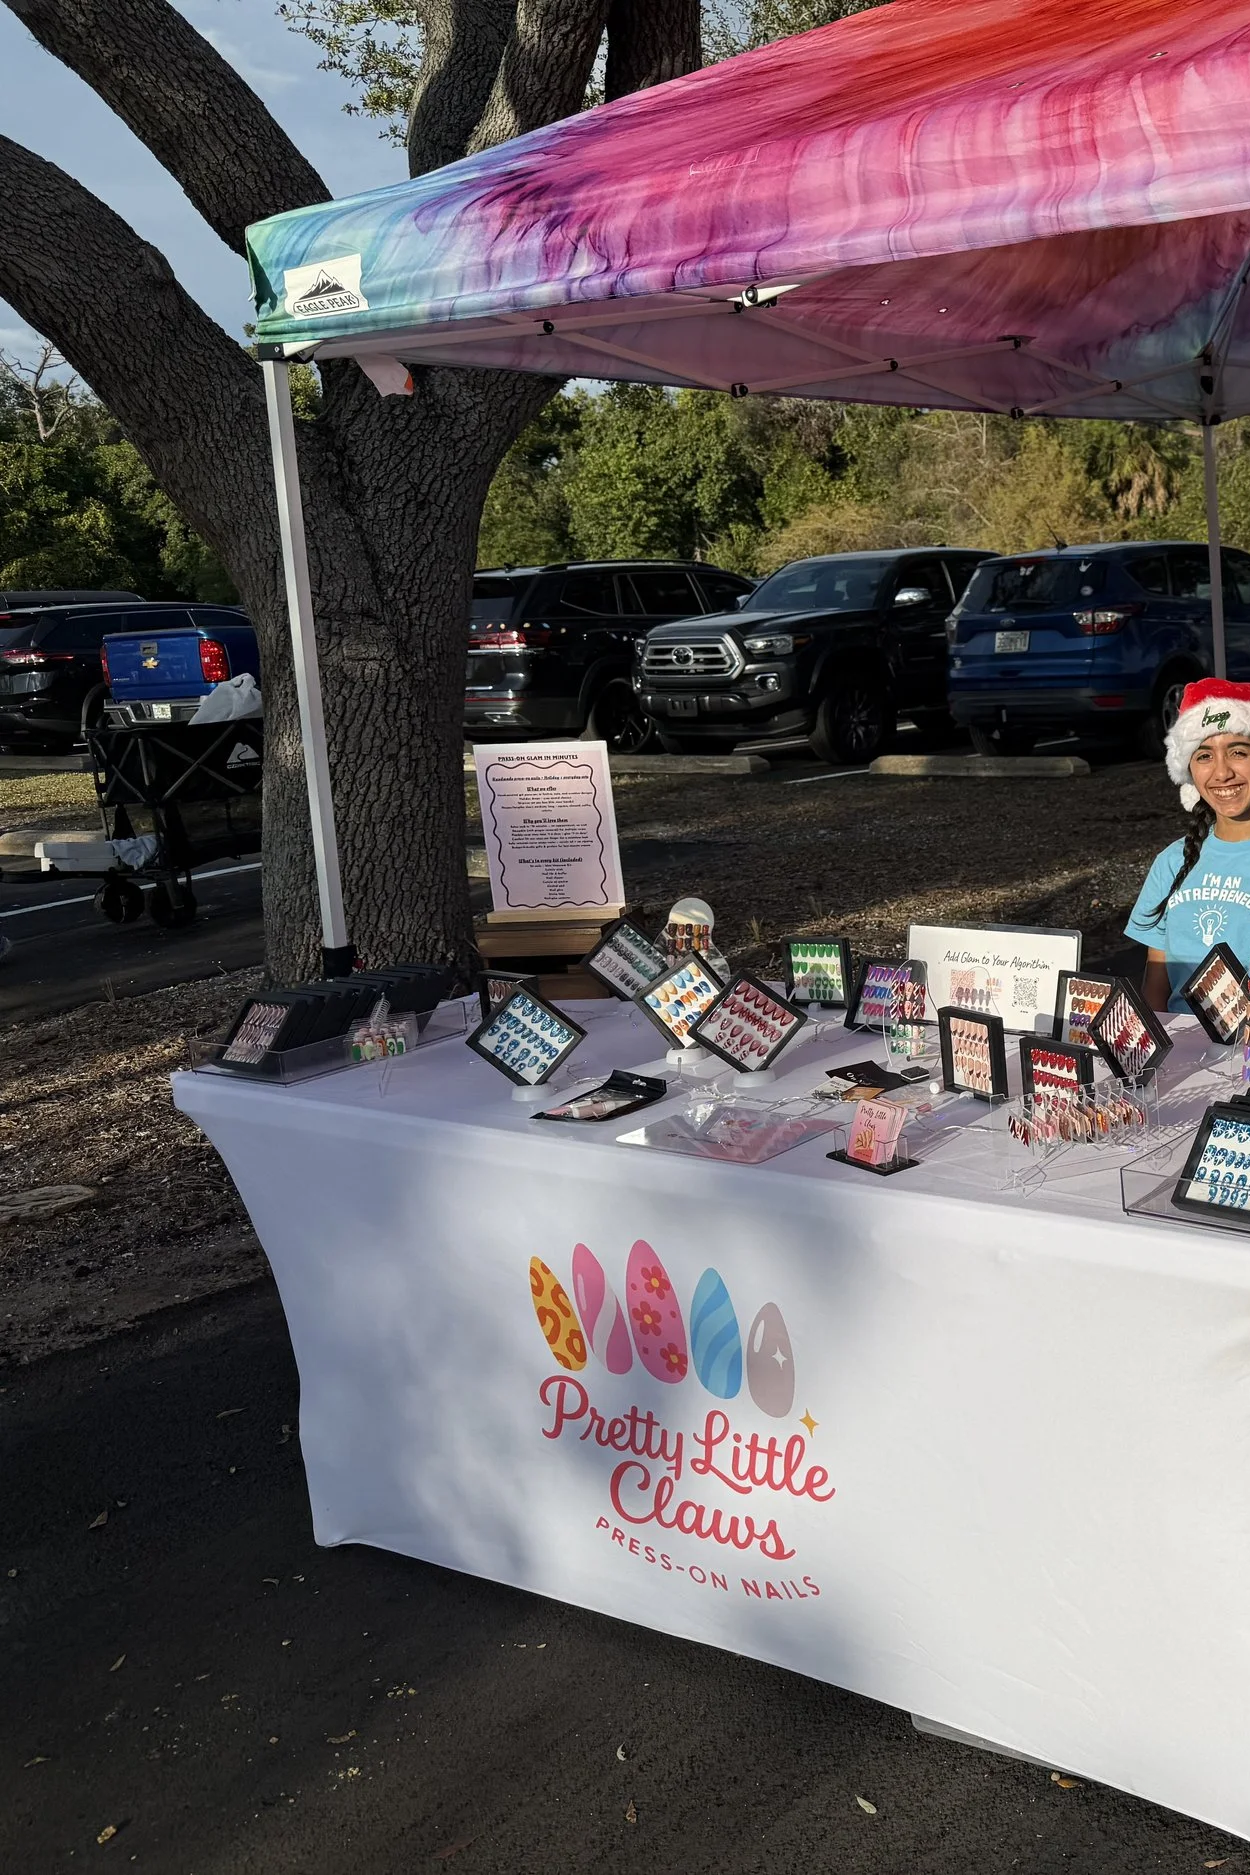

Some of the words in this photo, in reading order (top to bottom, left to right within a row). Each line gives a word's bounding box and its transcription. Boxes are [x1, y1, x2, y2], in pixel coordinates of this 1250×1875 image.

[296, 300, 326, 314] EAGLE
[328, 295, 356, 309] PEAK
[1202, 873, 1221, 888] I'M
[1223, 876, 1242, 889] AN
[943, 950, 960, 962] Add
[961, 951, 980, 964] Glam
[982, 956, 990, 965] to
[992, 955, 1009, 967] Your
[538, 1374, 684, 1481] Pretty
[690, 1409, 836, 1502] Little
[610, 1460, 797, 1561] Claws
[595, 1516, 728, 1592] PRESS-ON
[740, 1575, 820, 1601] NAILS
